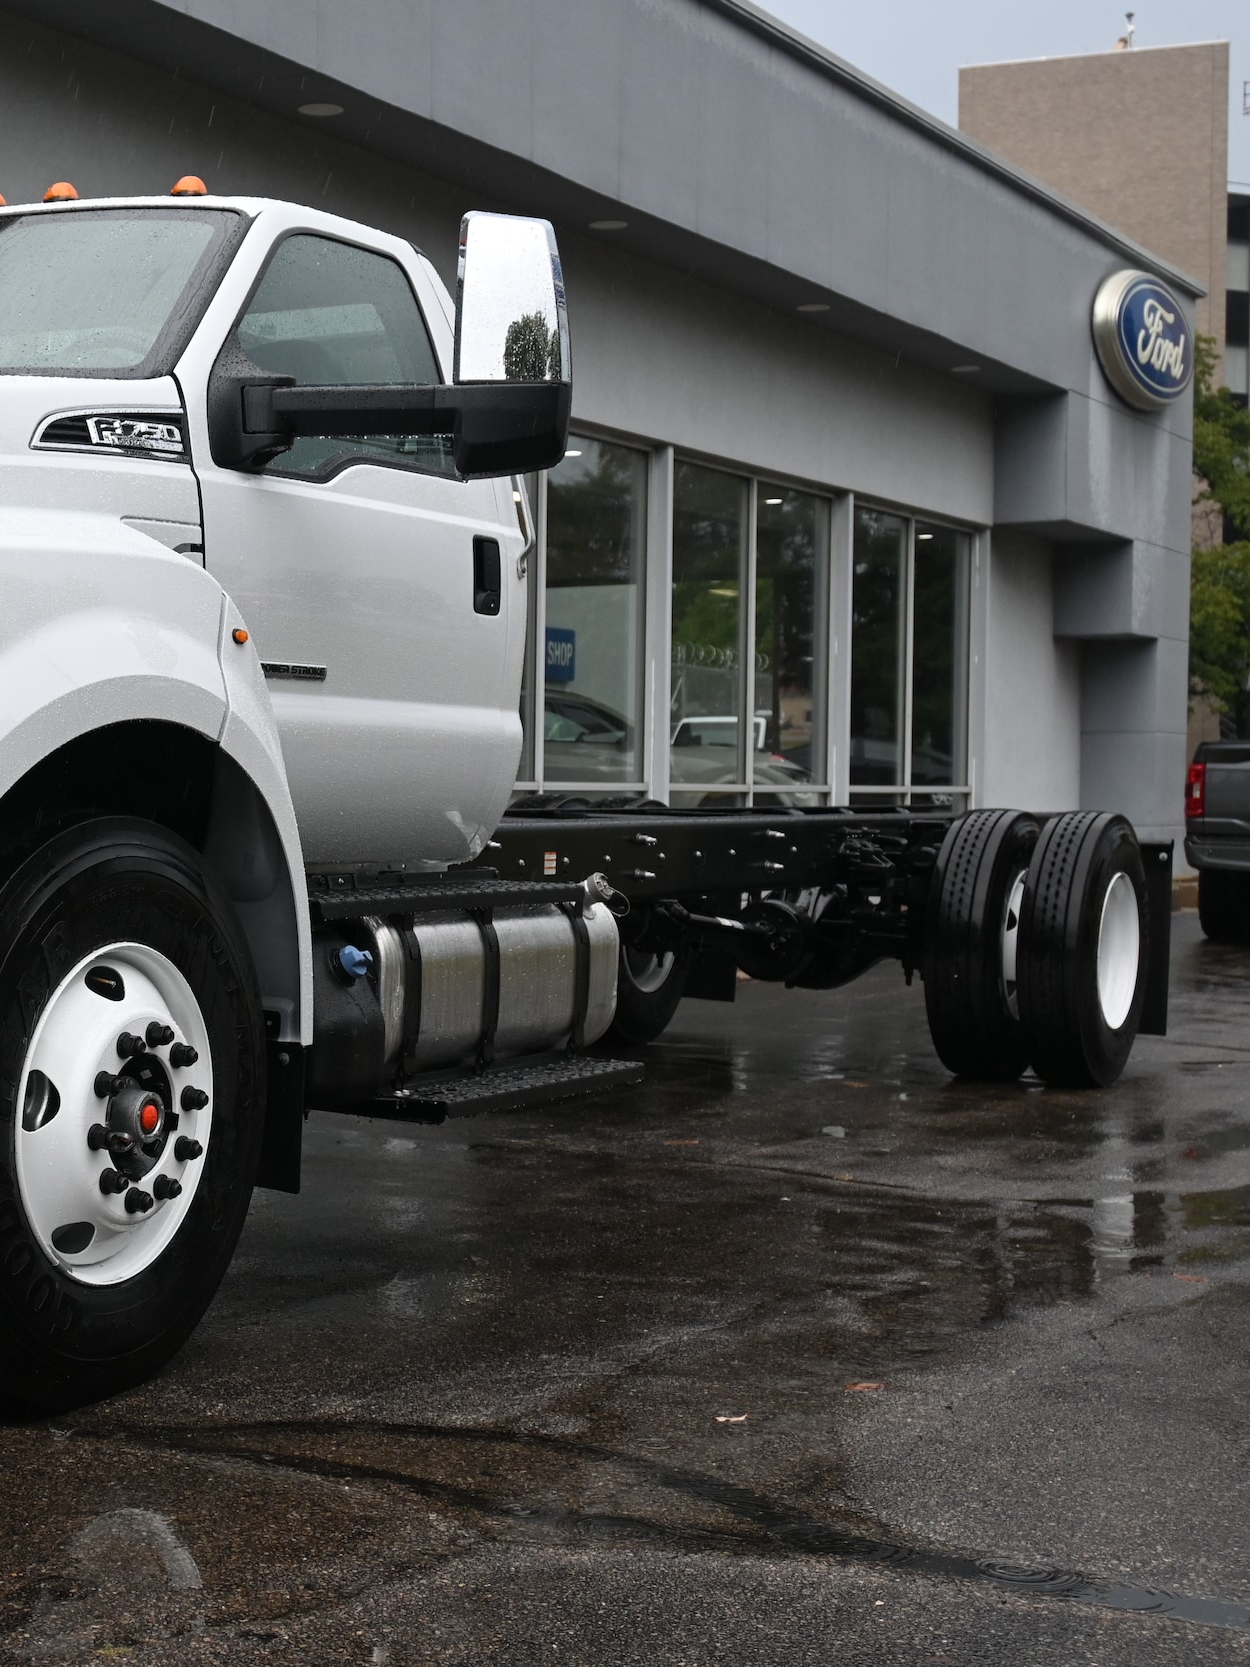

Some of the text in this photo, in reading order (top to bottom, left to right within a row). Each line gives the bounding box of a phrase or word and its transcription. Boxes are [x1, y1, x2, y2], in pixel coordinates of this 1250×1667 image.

[1137, 298, 1185, 380] Ford
[547, 640, 574, 667] SHOP
[290, 665, 326, 677] STROKE
